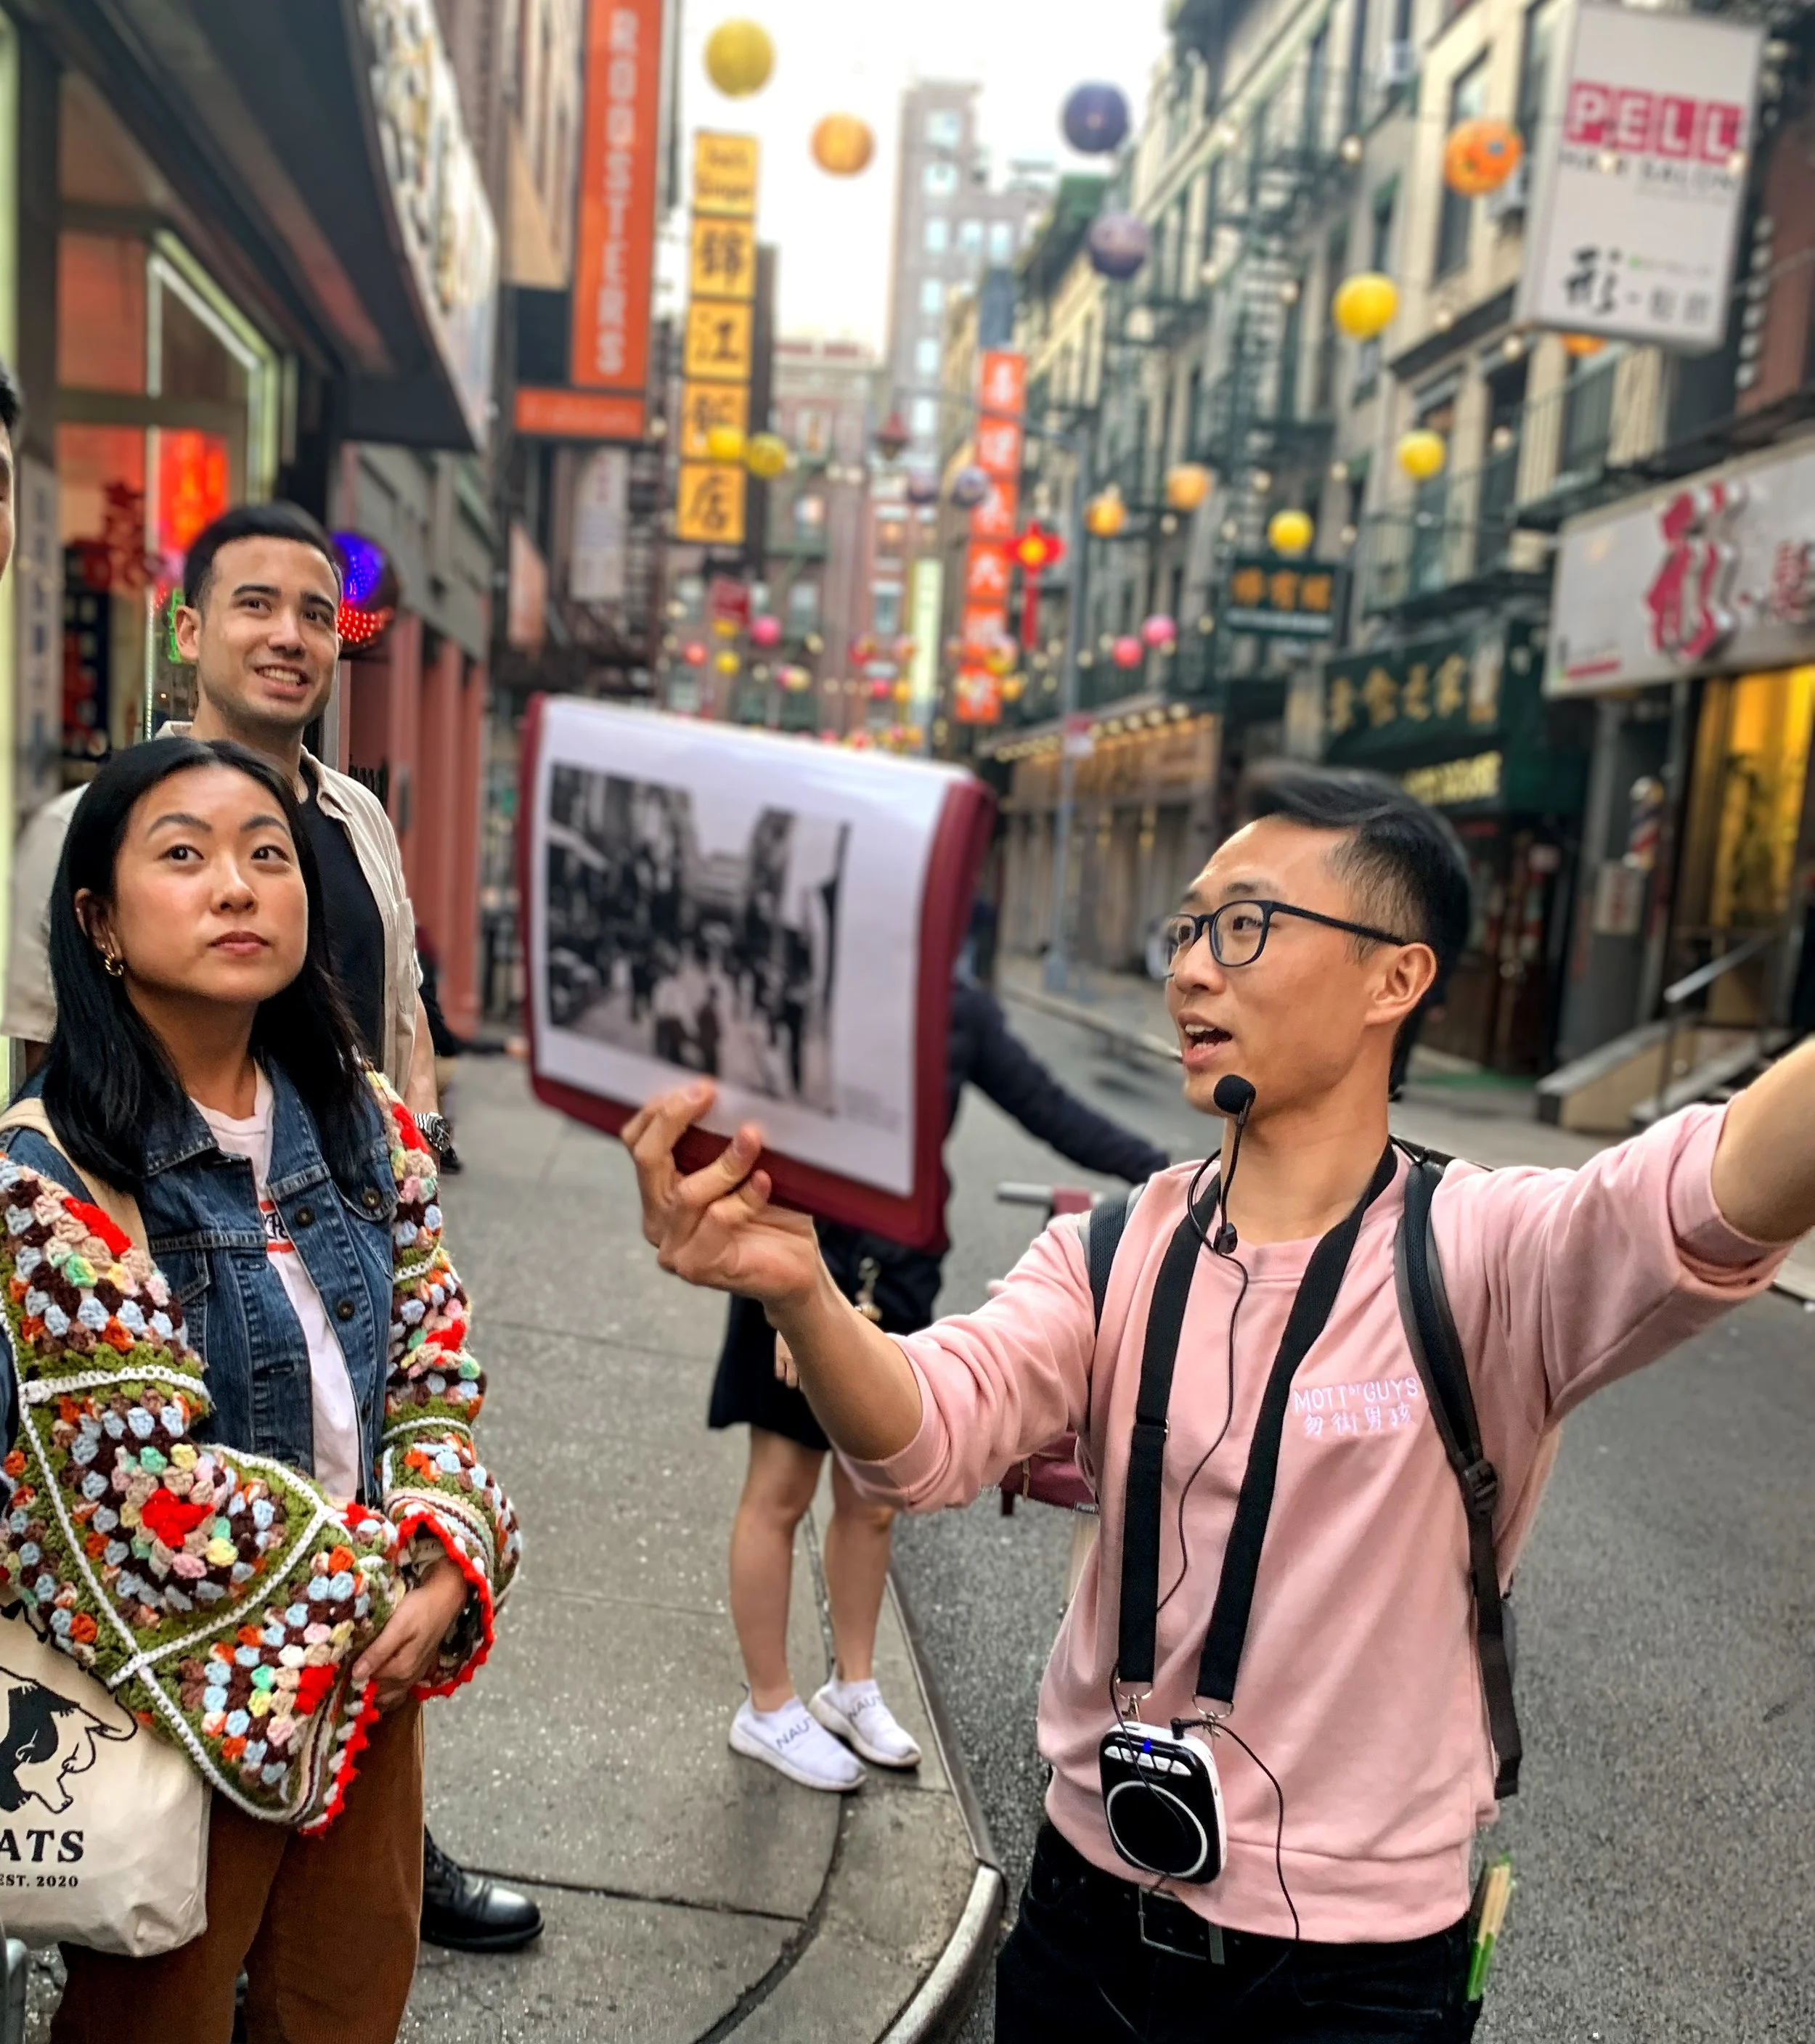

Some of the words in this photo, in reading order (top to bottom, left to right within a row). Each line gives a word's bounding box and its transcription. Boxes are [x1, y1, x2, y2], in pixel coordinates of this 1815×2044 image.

[1568, 87, 1735, 160] PELL
[1559, 149, 1627, 175] HAR
[1294, 1385, 1347, 1413] MOTT
[1363, 1377, 1419, 1403] GUYS
[0, 1828, 84, 1863] ATS
[36, 1875, 79, 1888] 2020
